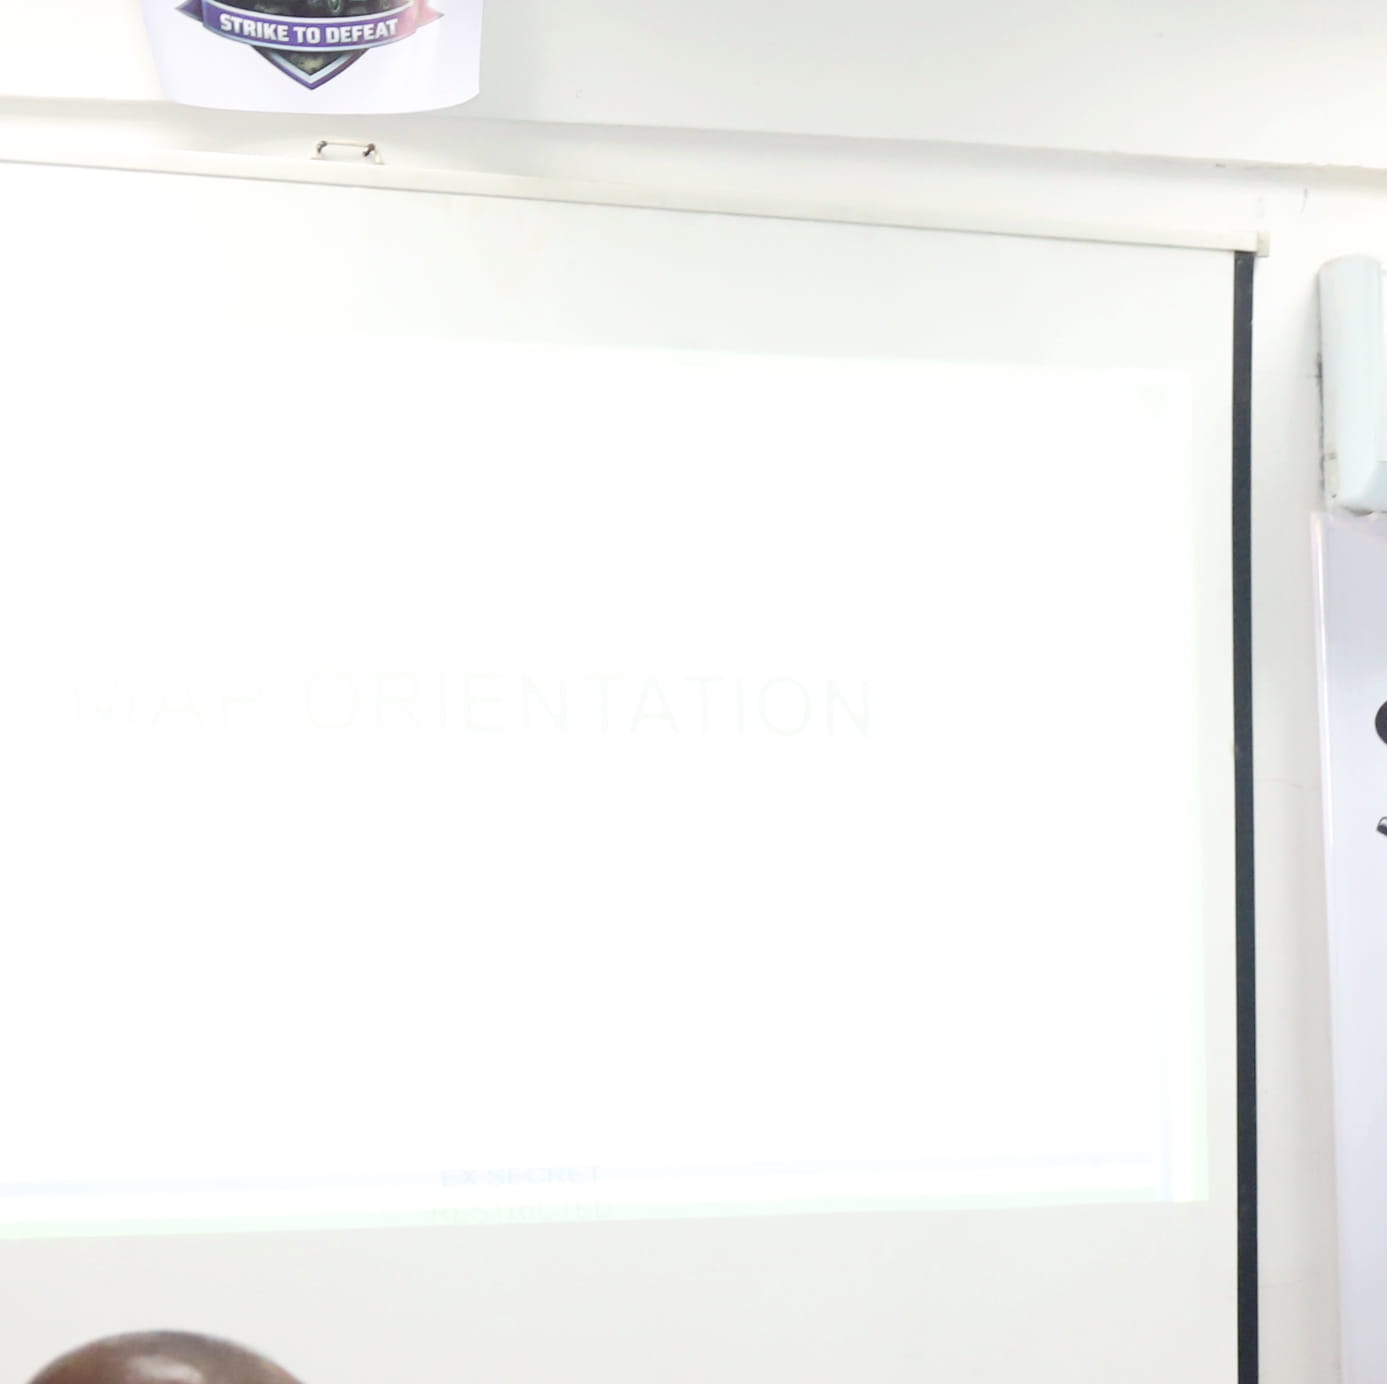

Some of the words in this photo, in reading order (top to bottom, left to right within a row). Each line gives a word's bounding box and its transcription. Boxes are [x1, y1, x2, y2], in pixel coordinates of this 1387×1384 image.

[220, 14, 289, 42] STRIKE
[294, 26, 321, 44] TO
[326, 18, 399, 44] DEFEAT
[302, 664, 874, 739] ORIENTATION
